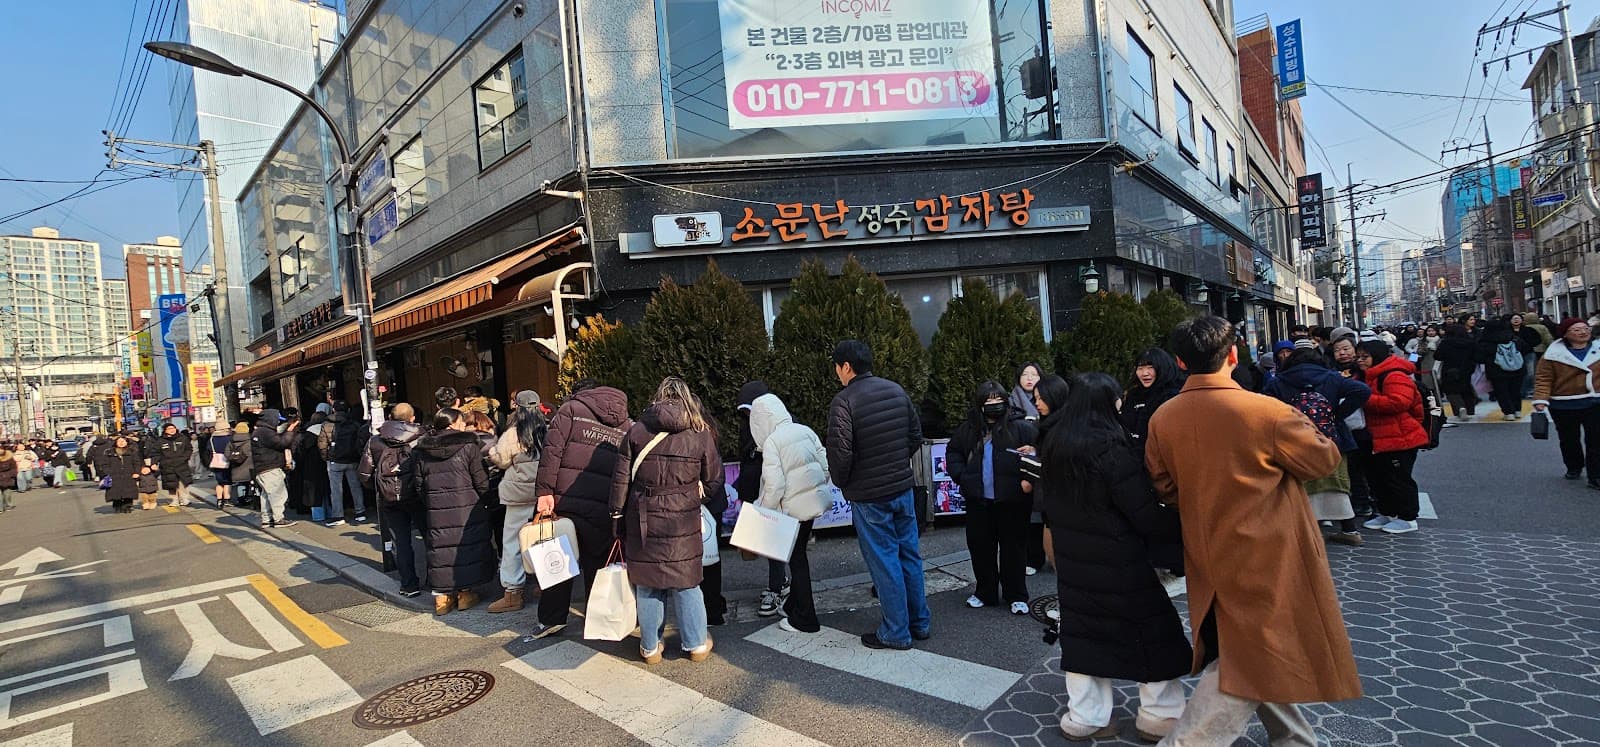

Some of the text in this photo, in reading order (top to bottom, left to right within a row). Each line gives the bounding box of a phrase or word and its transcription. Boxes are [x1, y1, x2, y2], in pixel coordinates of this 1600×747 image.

[821, 0, 892, 18] INCOMIZ
[747, 21, 968, 46] 본 건물 2층/70평 팝업대관
[828, 50, 864, 69] 외벽
[868, 48, 904, 68] 광고
[909, 47, 954, 66] 문의”
[746, 76, 977, 112] 010-7711-0813
[730, 201, 850, 243] 소문난
[858, 205, 911, 234] 성수
[915, 188, 1035, 232] 감자탕
[193, 365, 211, 399] 부동산
